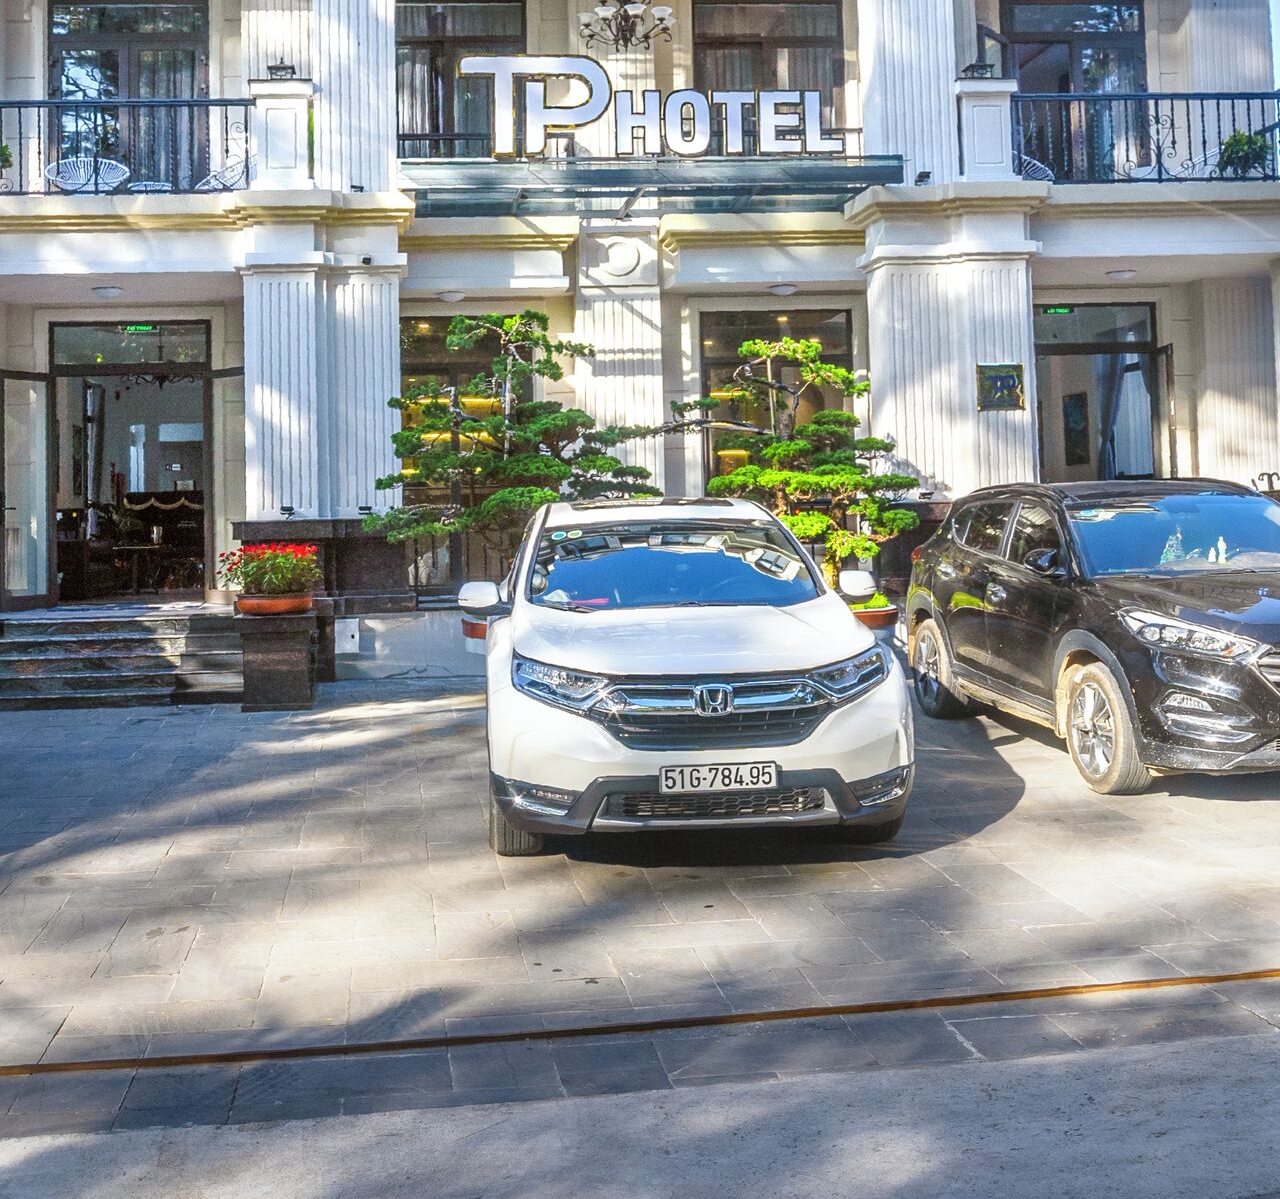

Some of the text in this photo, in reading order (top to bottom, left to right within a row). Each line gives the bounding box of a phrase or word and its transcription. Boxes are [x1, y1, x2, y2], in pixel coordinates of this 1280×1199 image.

[457, 55, 844, 157] TP HOTEL
[664, 765, 773, 790] 51G-784.95
